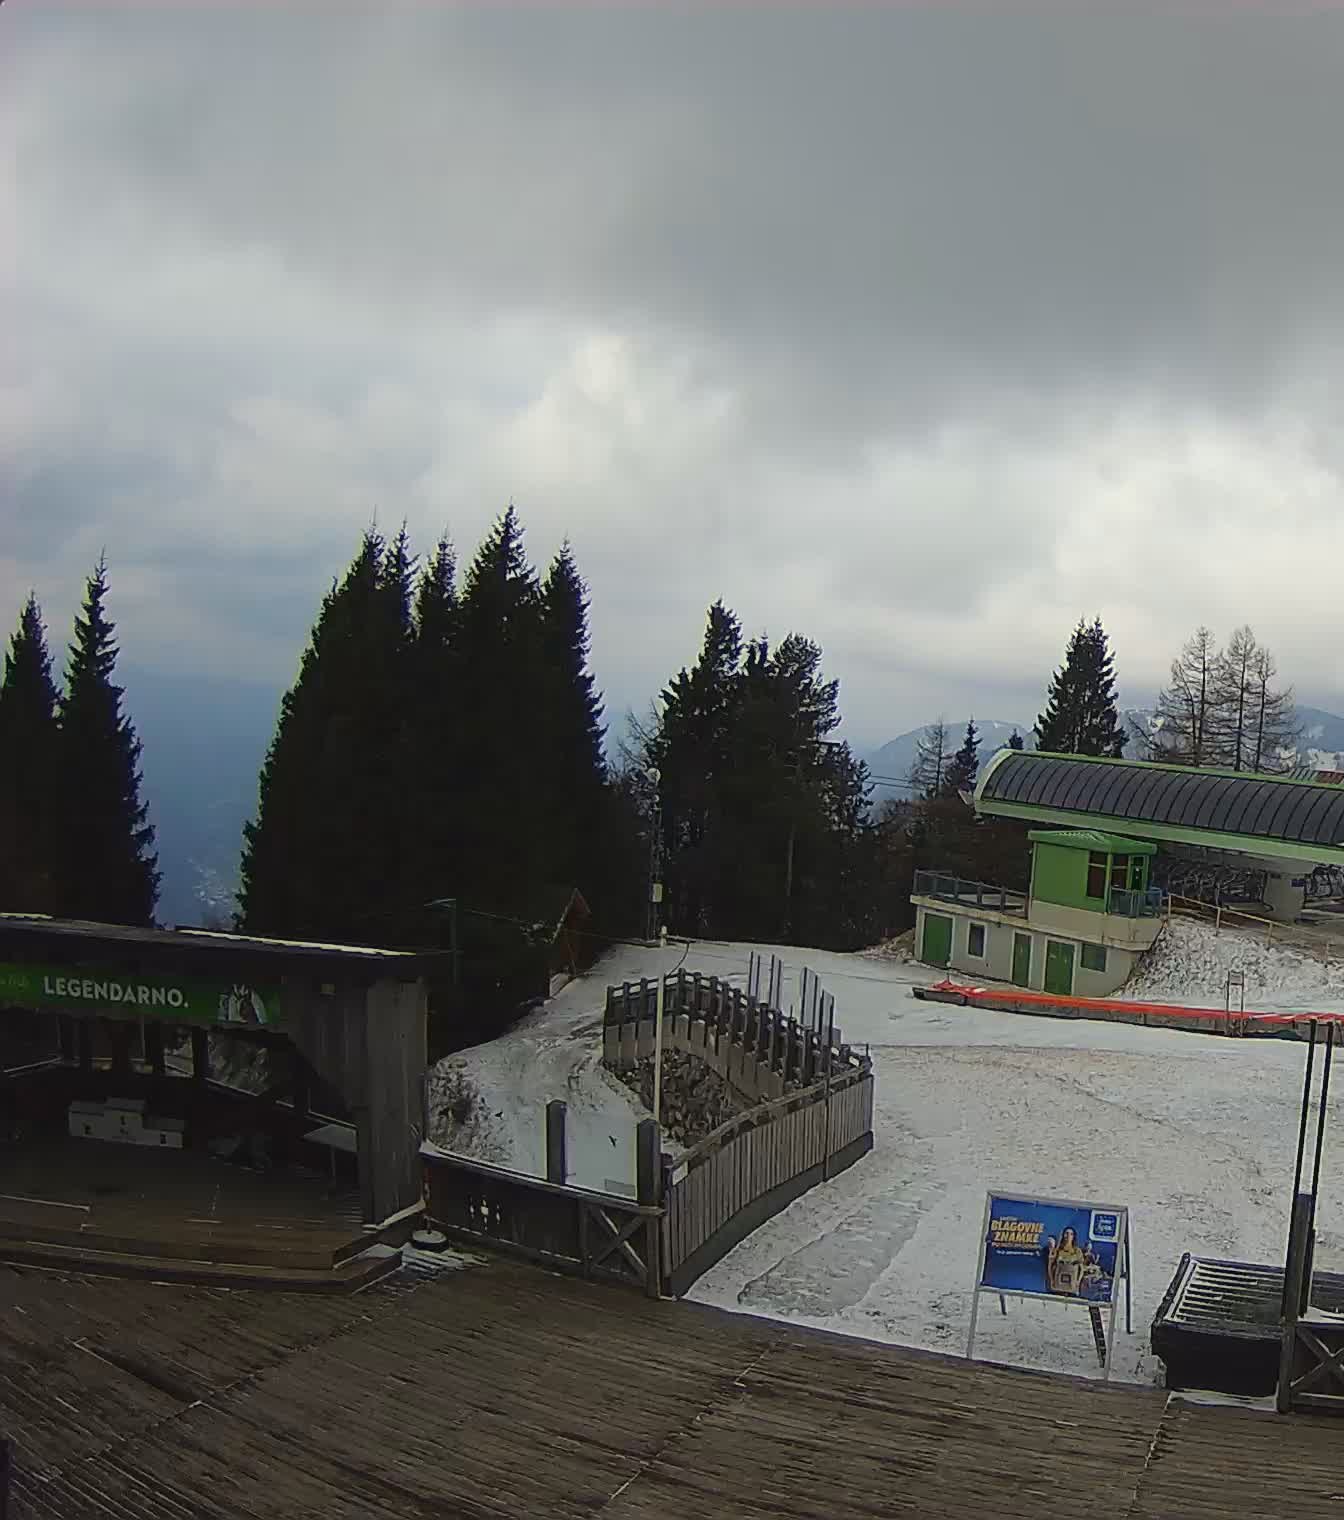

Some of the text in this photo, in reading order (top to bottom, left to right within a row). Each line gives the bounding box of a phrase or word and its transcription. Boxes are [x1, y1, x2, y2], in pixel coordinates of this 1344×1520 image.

[43, 975, 190, 1008] LEGENDARNO.
[991, 1221, 1044, 1233] BLAGOVNE
[994, 1232, 1040, 1243] ZNAMKE
